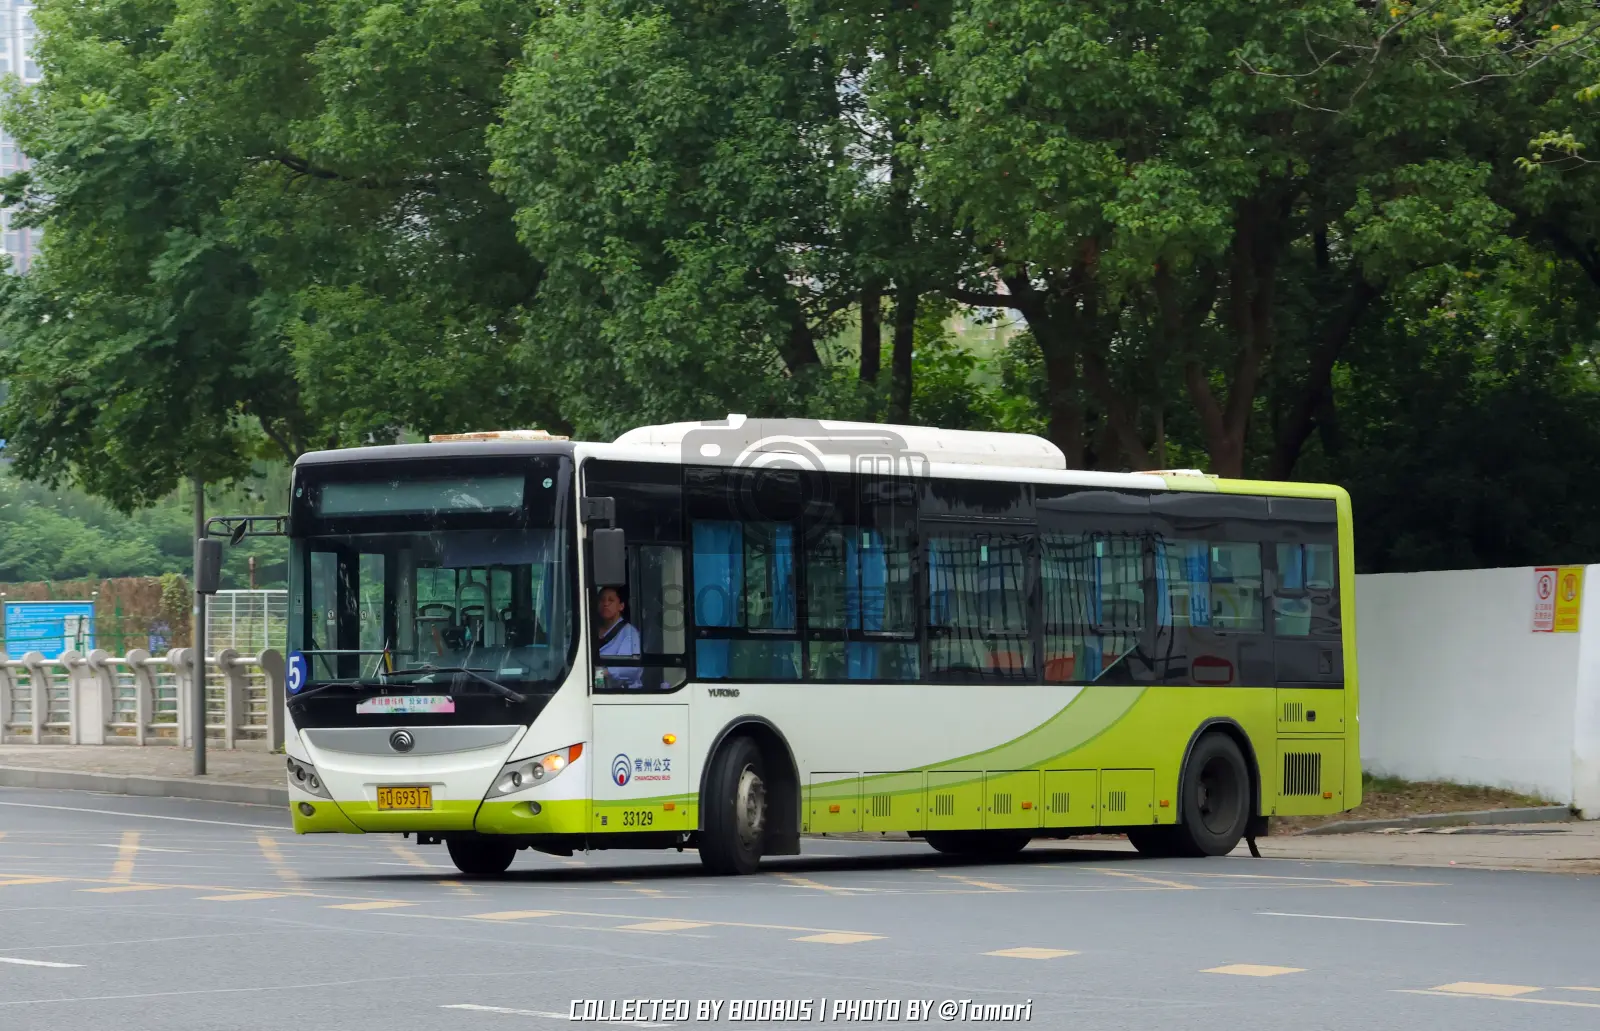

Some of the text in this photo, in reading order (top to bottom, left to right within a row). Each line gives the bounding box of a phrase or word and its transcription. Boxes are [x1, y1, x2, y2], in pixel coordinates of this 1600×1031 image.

[288, 655, 300, 690] 5
[634, 758, 671, 772] 常州公交
[622, 810, 653, 826] 33129
